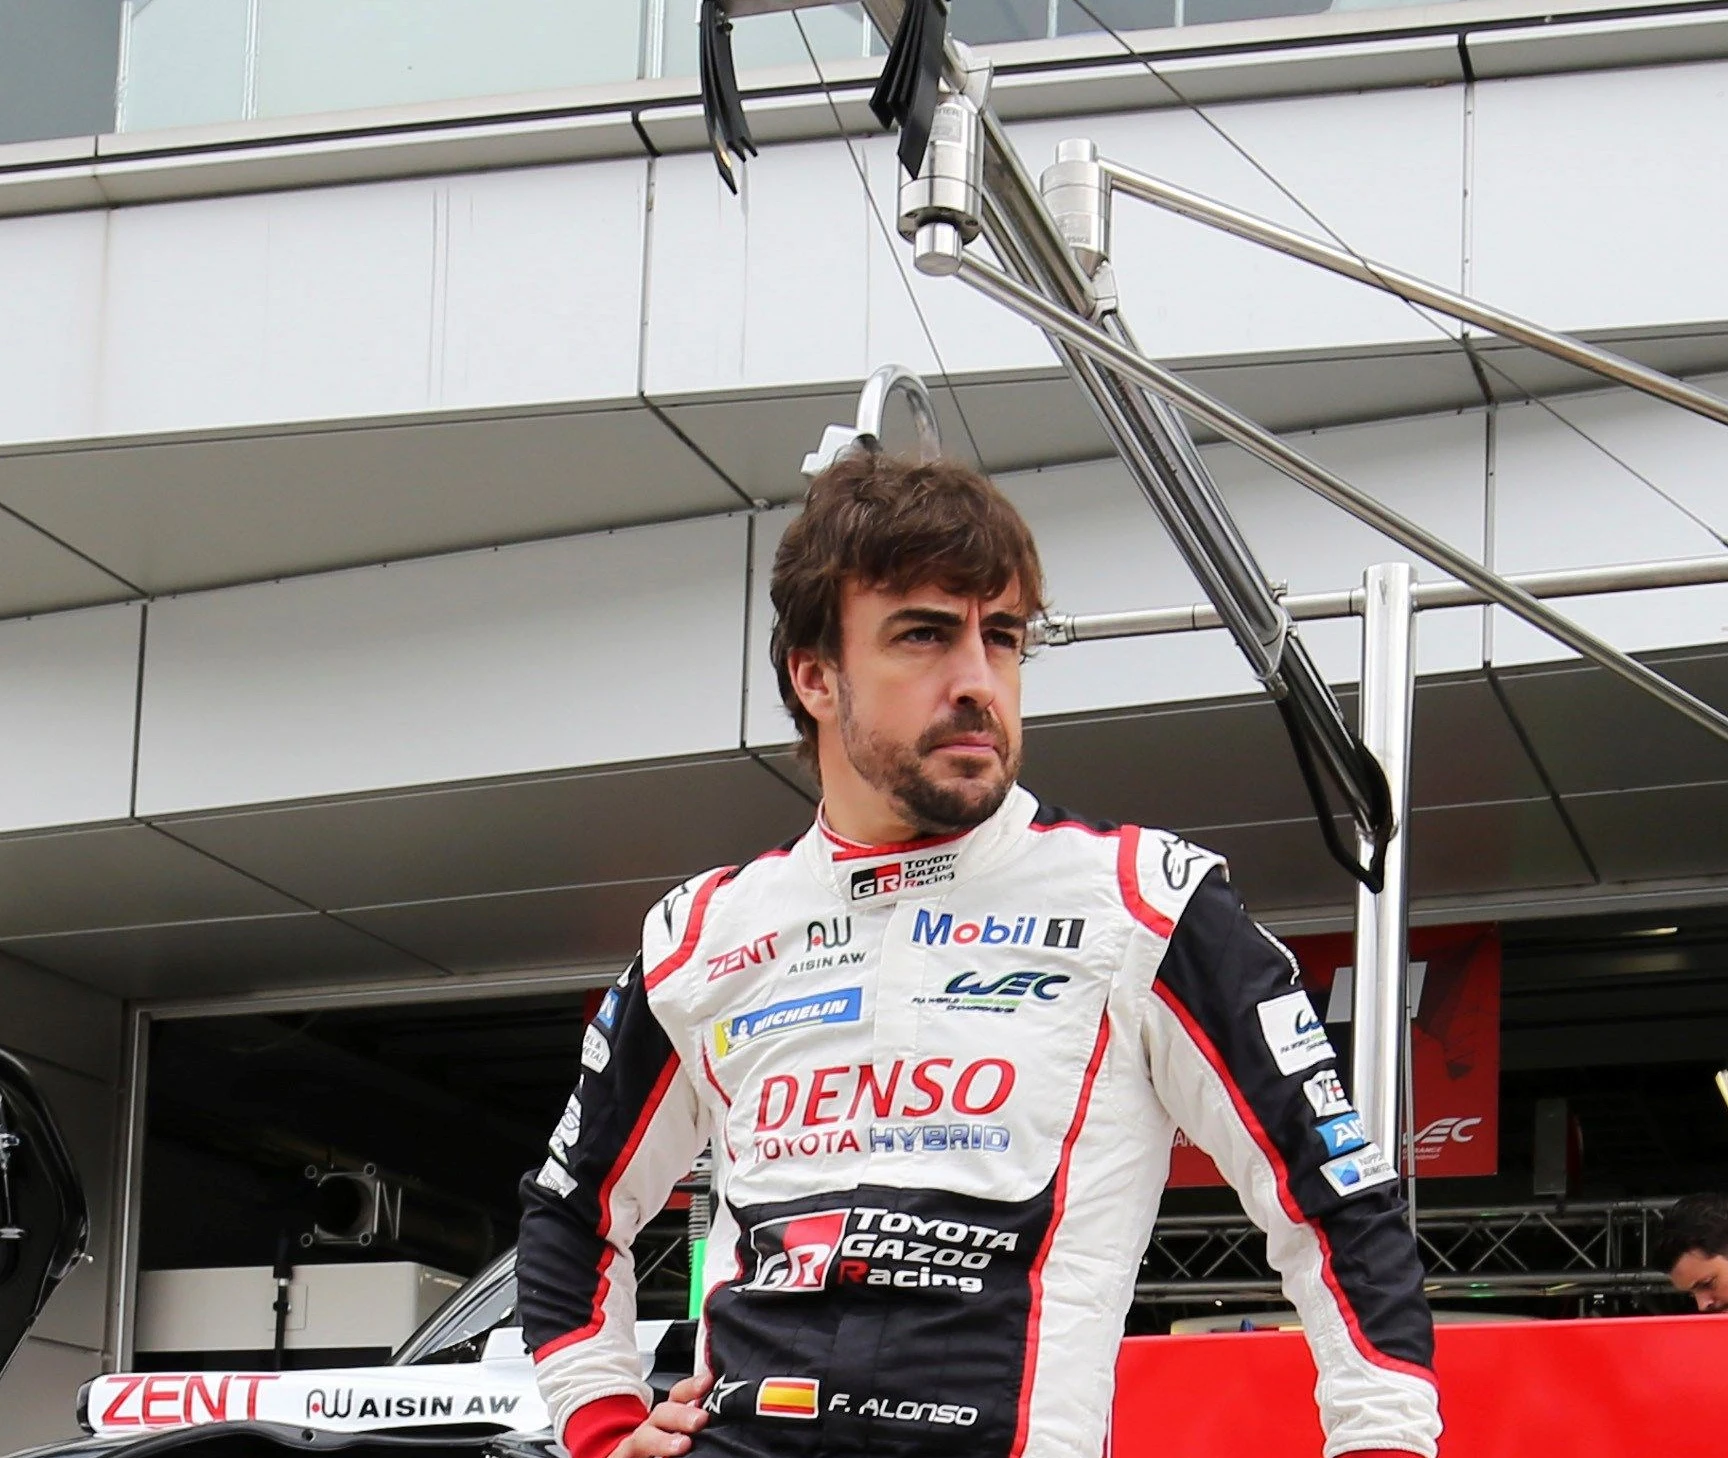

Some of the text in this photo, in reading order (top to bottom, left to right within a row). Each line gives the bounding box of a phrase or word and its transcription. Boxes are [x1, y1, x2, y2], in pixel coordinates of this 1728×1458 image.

[904, 871, 956, 890] Racing
[912, 909, 1038, 947] Mobil
[706, 931, 779, 983] ZENT
[786, 951, 868, 976] AISIN AW
[945, 969, 1073, 1001] WEC
[752, 998, 850, 1034] MICHELIN
[753, 1057, 1017, 1133] DENSO
[754, 1124, 1012, 1165] TOYOTA HYBRID
[850, 1207, 1021, 1252] TOYOTA
[840, 1233, 994, 1270] GAZOO
[837, 1260, 985, 1294] Racing
[99, 1374, 281, 1426] ZENT
[358, 1393, 453, 1418] AISIN
[464, 1393, 523, 1416] AW
[828, 1393, 980, 1427] F. ALONSO
